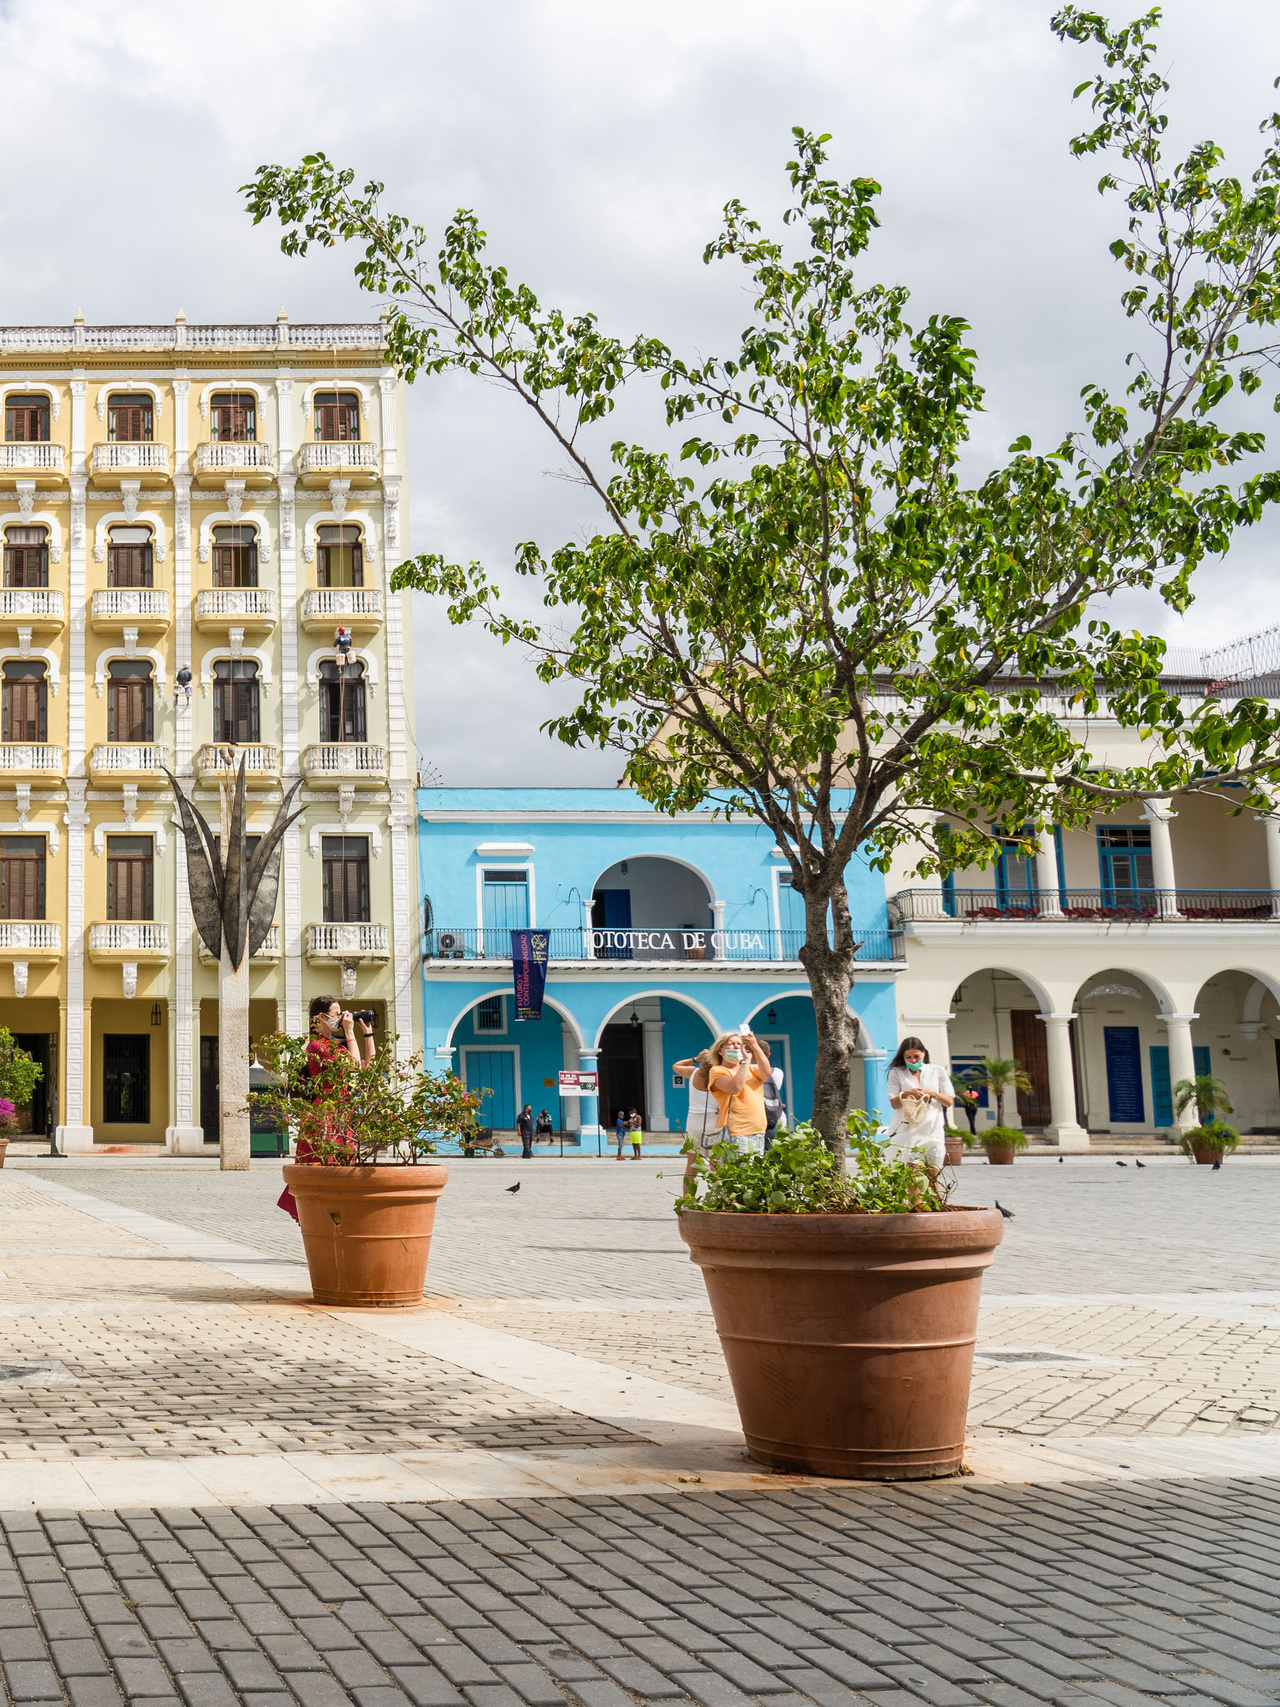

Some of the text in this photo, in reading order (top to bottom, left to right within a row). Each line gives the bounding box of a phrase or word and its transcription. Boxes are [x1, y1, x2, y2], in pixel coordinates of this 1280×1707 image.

[583, 931, 765, 950] FOTOTECA DE CUBA
[520, 934, 530, 1006] CONTEMPORANEIDAD
